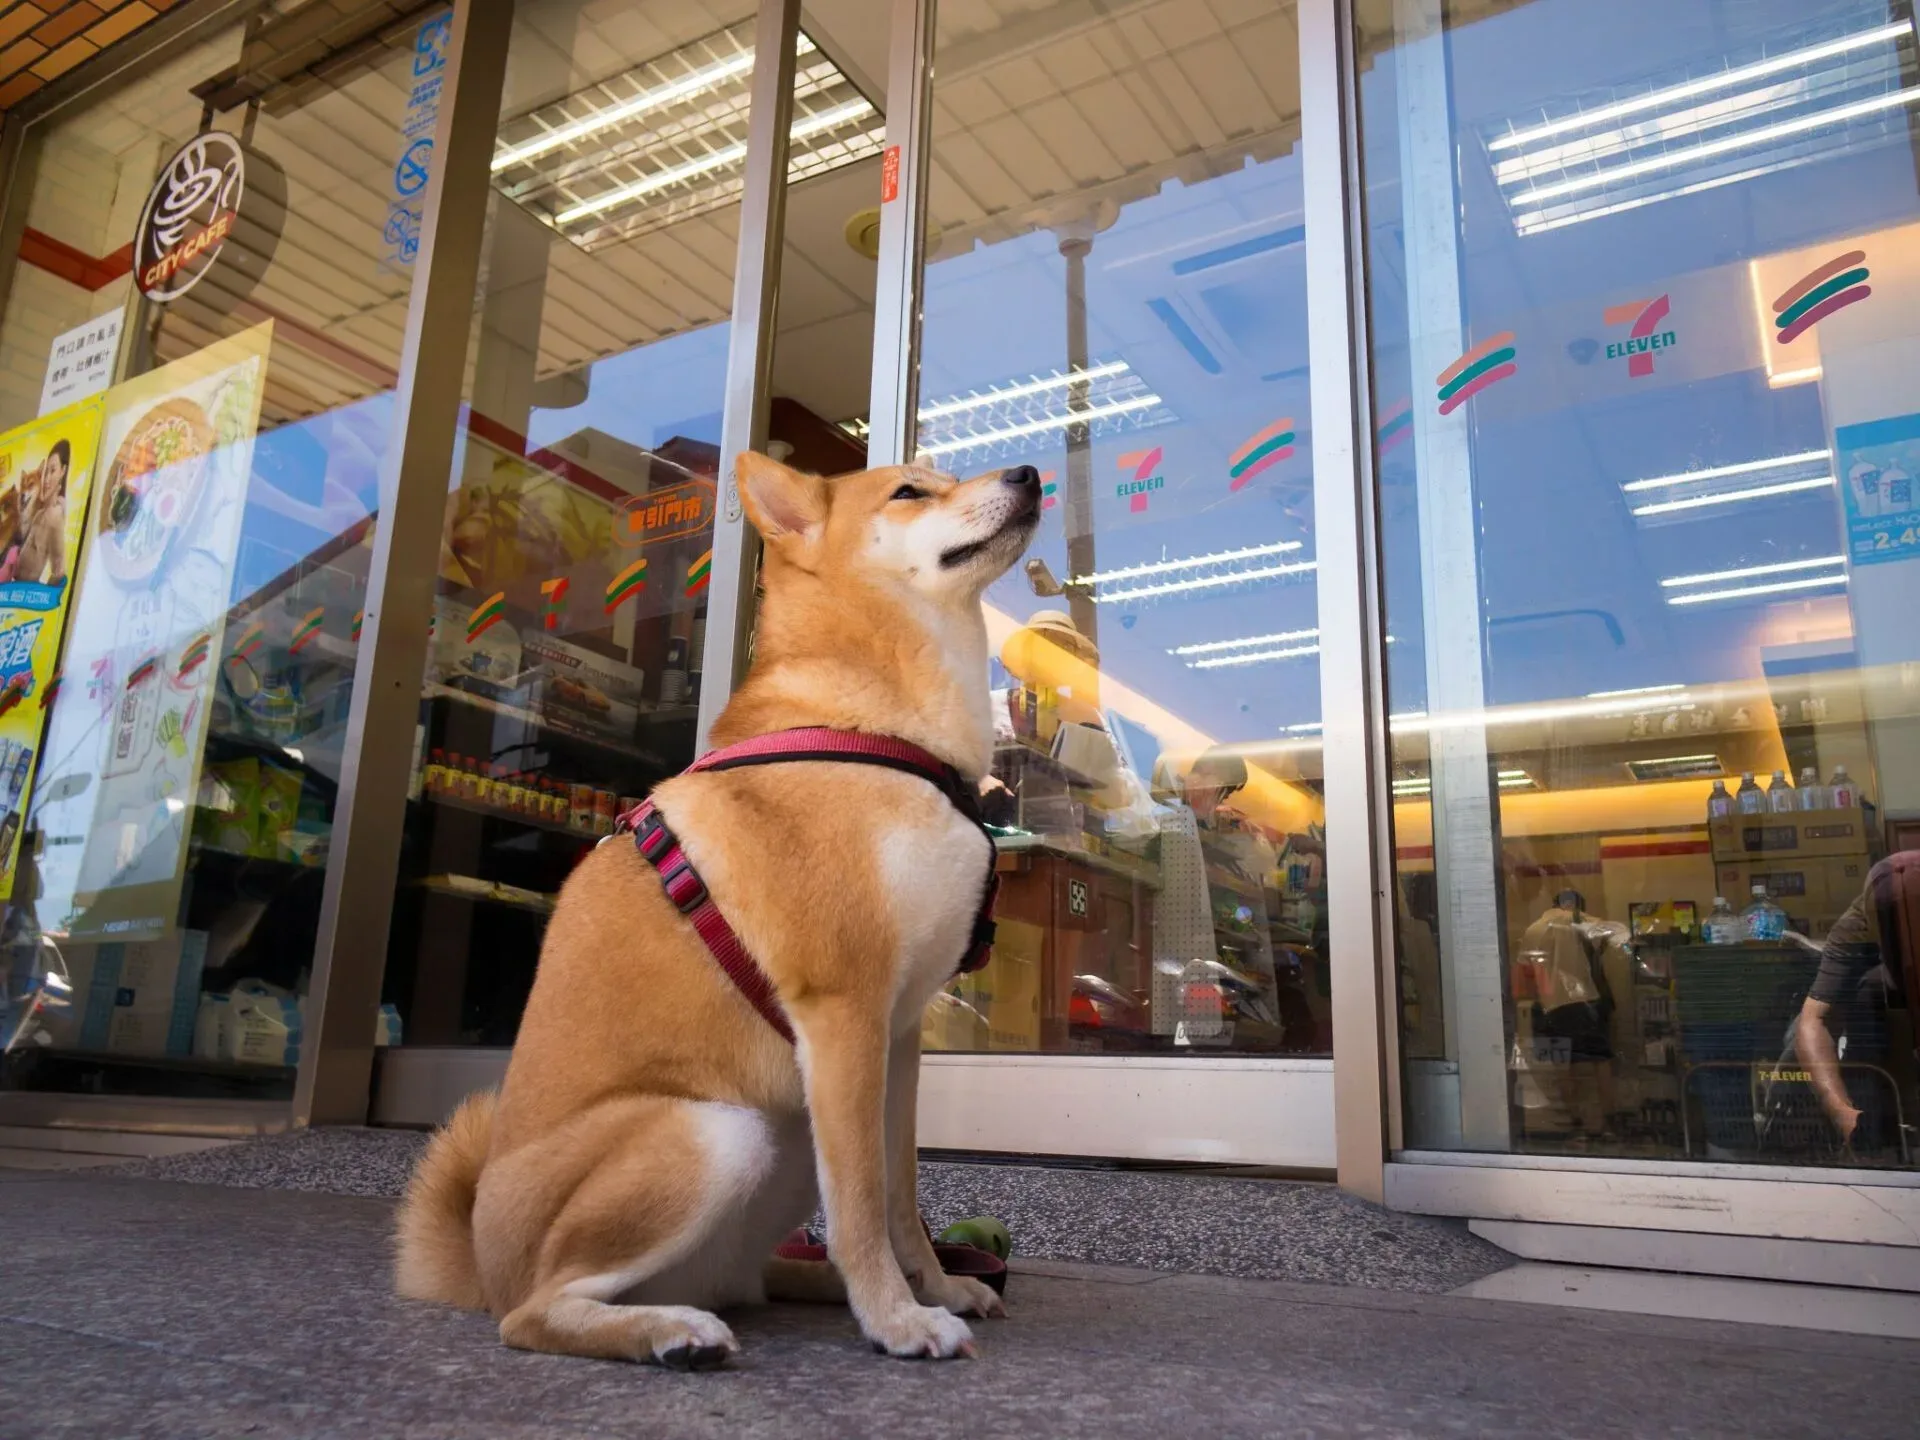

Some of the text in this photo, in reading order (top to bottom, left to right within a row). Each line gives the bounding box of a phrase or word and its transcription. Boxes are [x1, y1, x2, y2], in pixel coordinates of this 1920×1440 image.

[145, 216, 228, 286] CITY CAFE
[1603, 293, 1670, 378] 7
[1117, 446, 1162, 513] 7
